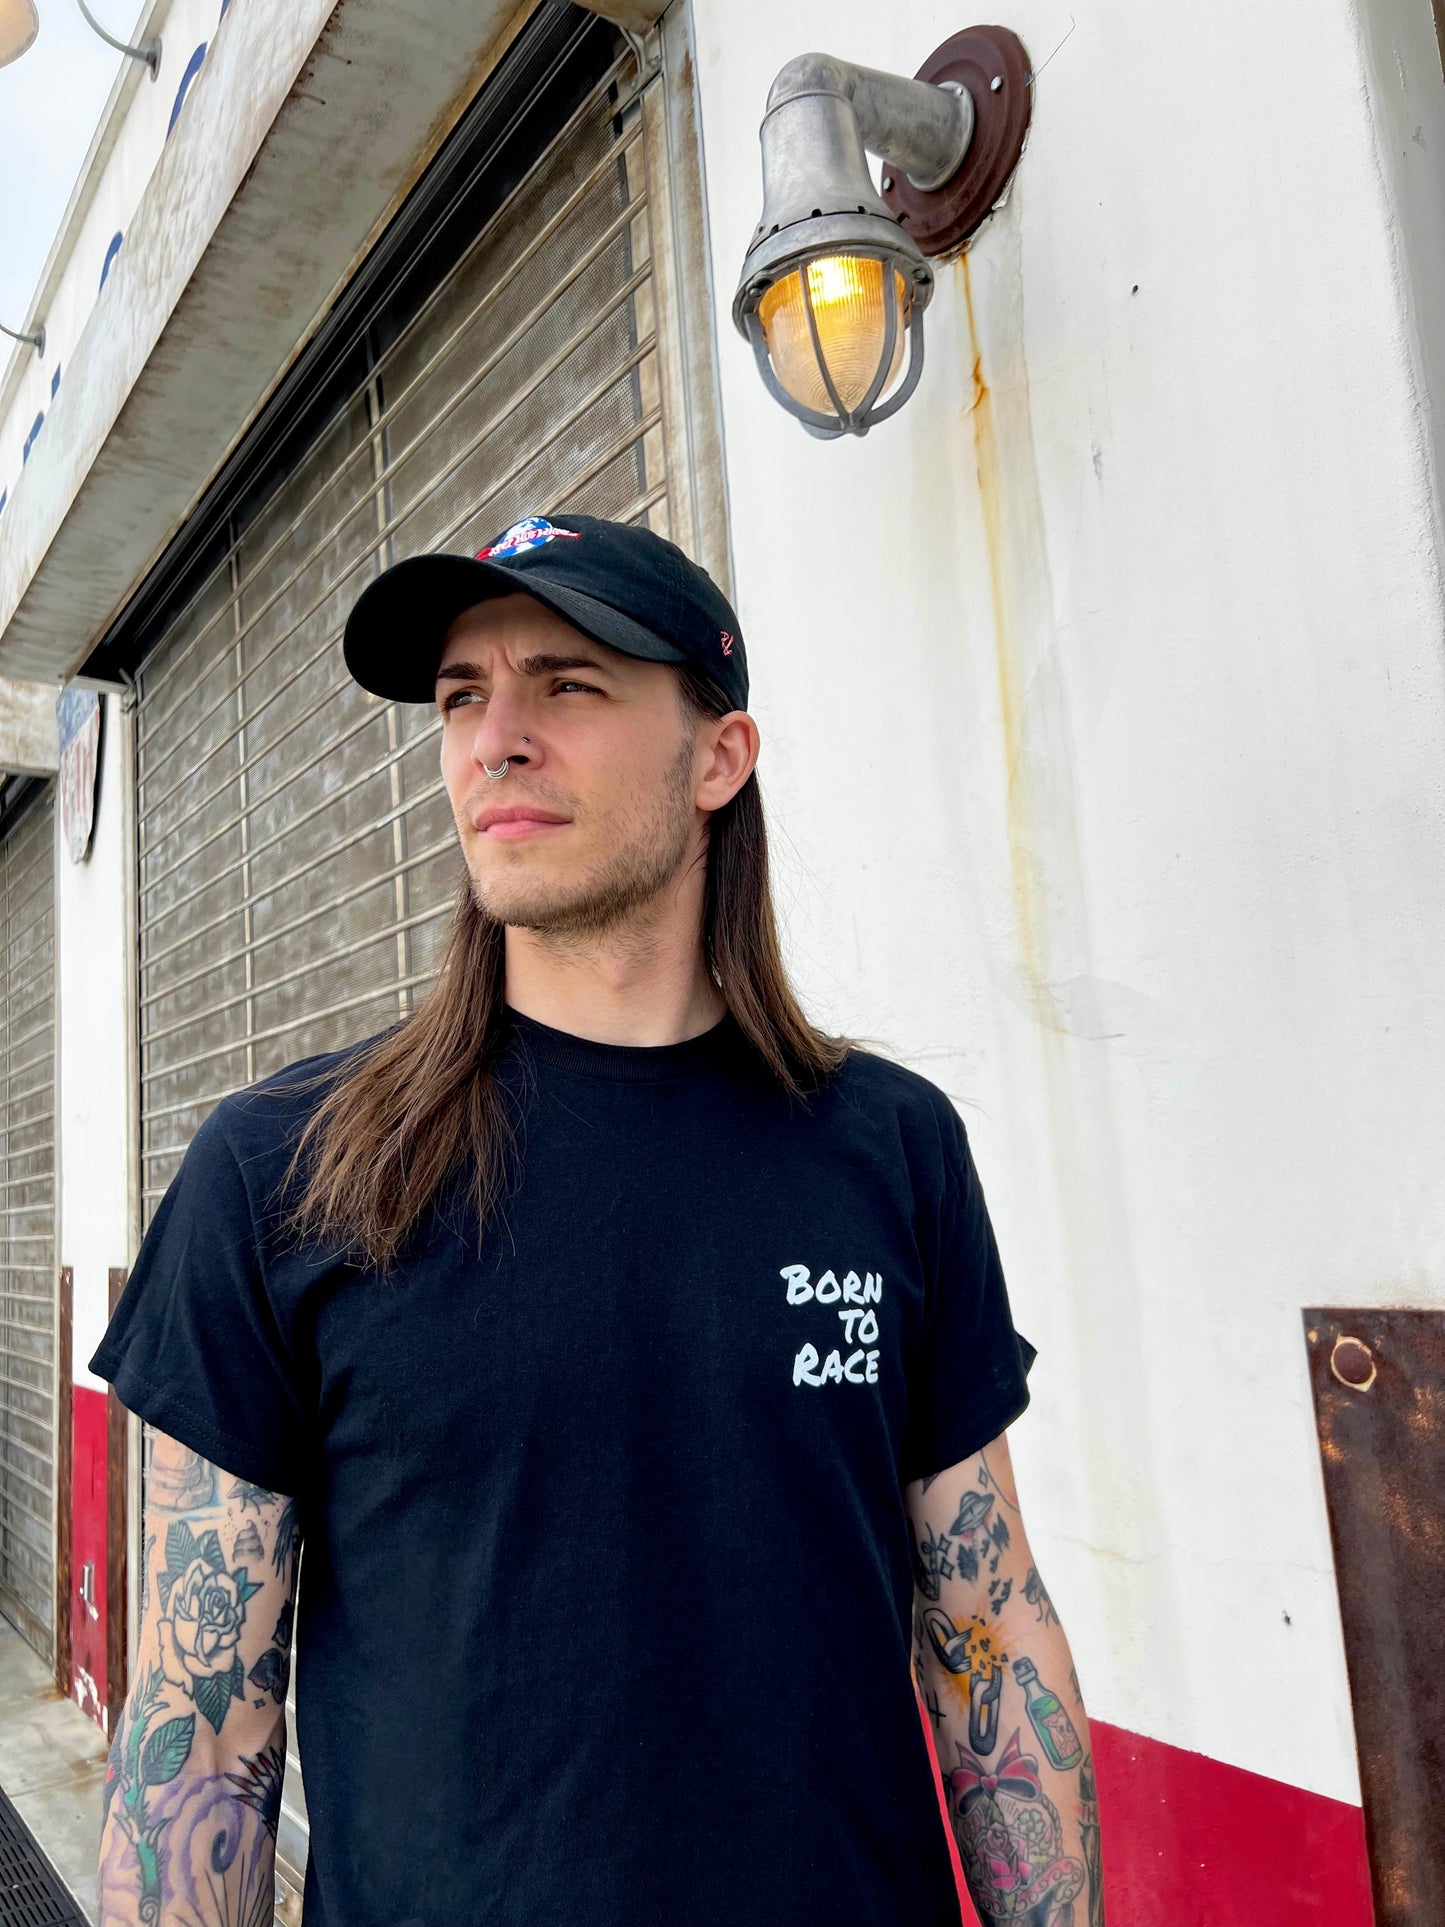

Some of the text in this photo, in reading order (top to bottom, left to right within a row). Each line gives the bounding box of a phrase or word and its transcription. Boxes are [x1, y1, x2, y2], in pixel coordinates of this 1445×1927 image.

[779, 1264, 883, 1306] BORN
[838, 1309, 880, 1344] TO
[792, 1342, 881, 1388] RACE
